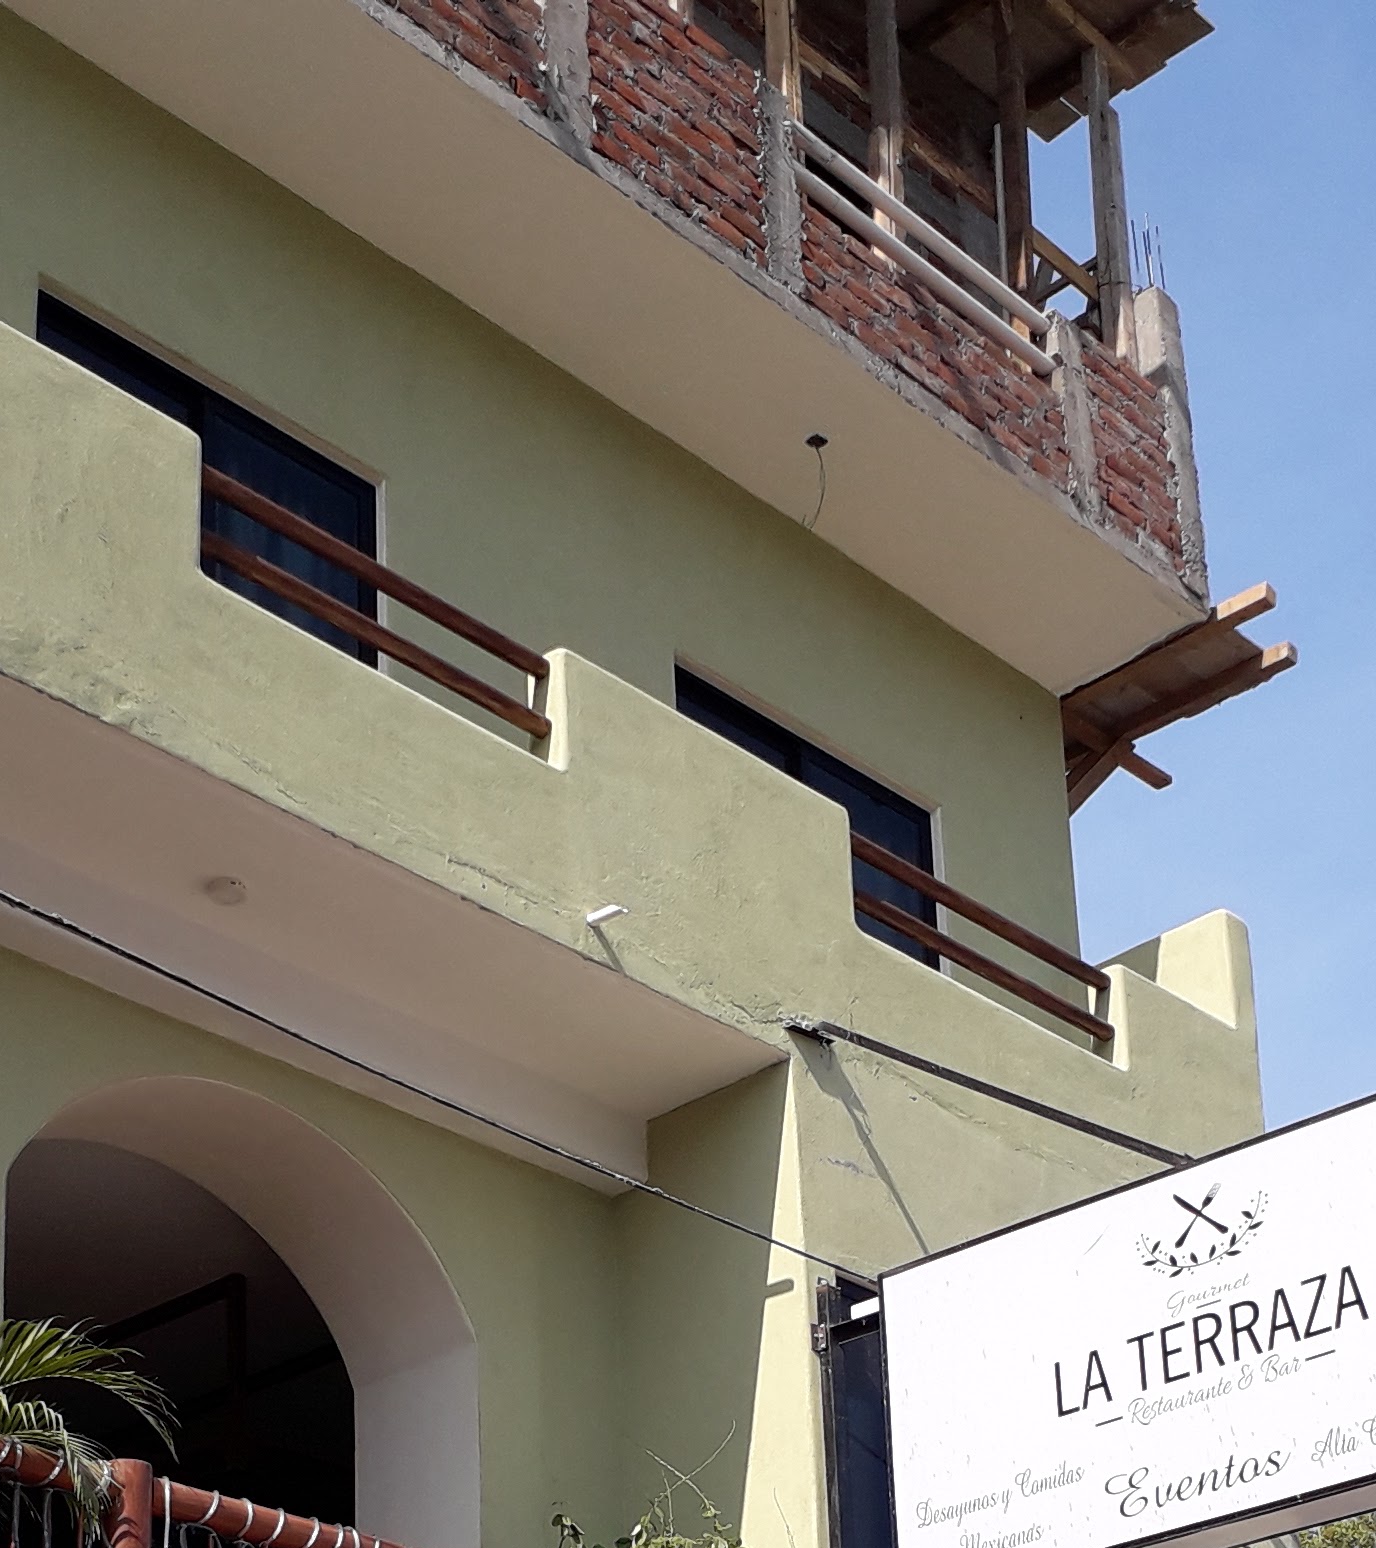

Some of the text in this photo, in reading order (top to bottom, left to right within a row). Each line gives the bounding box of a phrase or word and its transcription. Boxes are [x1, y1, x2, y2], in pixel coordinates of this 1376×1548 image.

[1167, 1273, 1251, 1318] Gourmet
[1054, 1265, 1370, 1418] LA TERRAZA
[1127, 1354, 1303, 1426] Restaurante & Bar
[1311, 1426, 1359, 1462] Alta
[915, 1461, 1085, 1529] Desayunos y Comidas
[1104, 1449, 1291, 1518] Eventos
